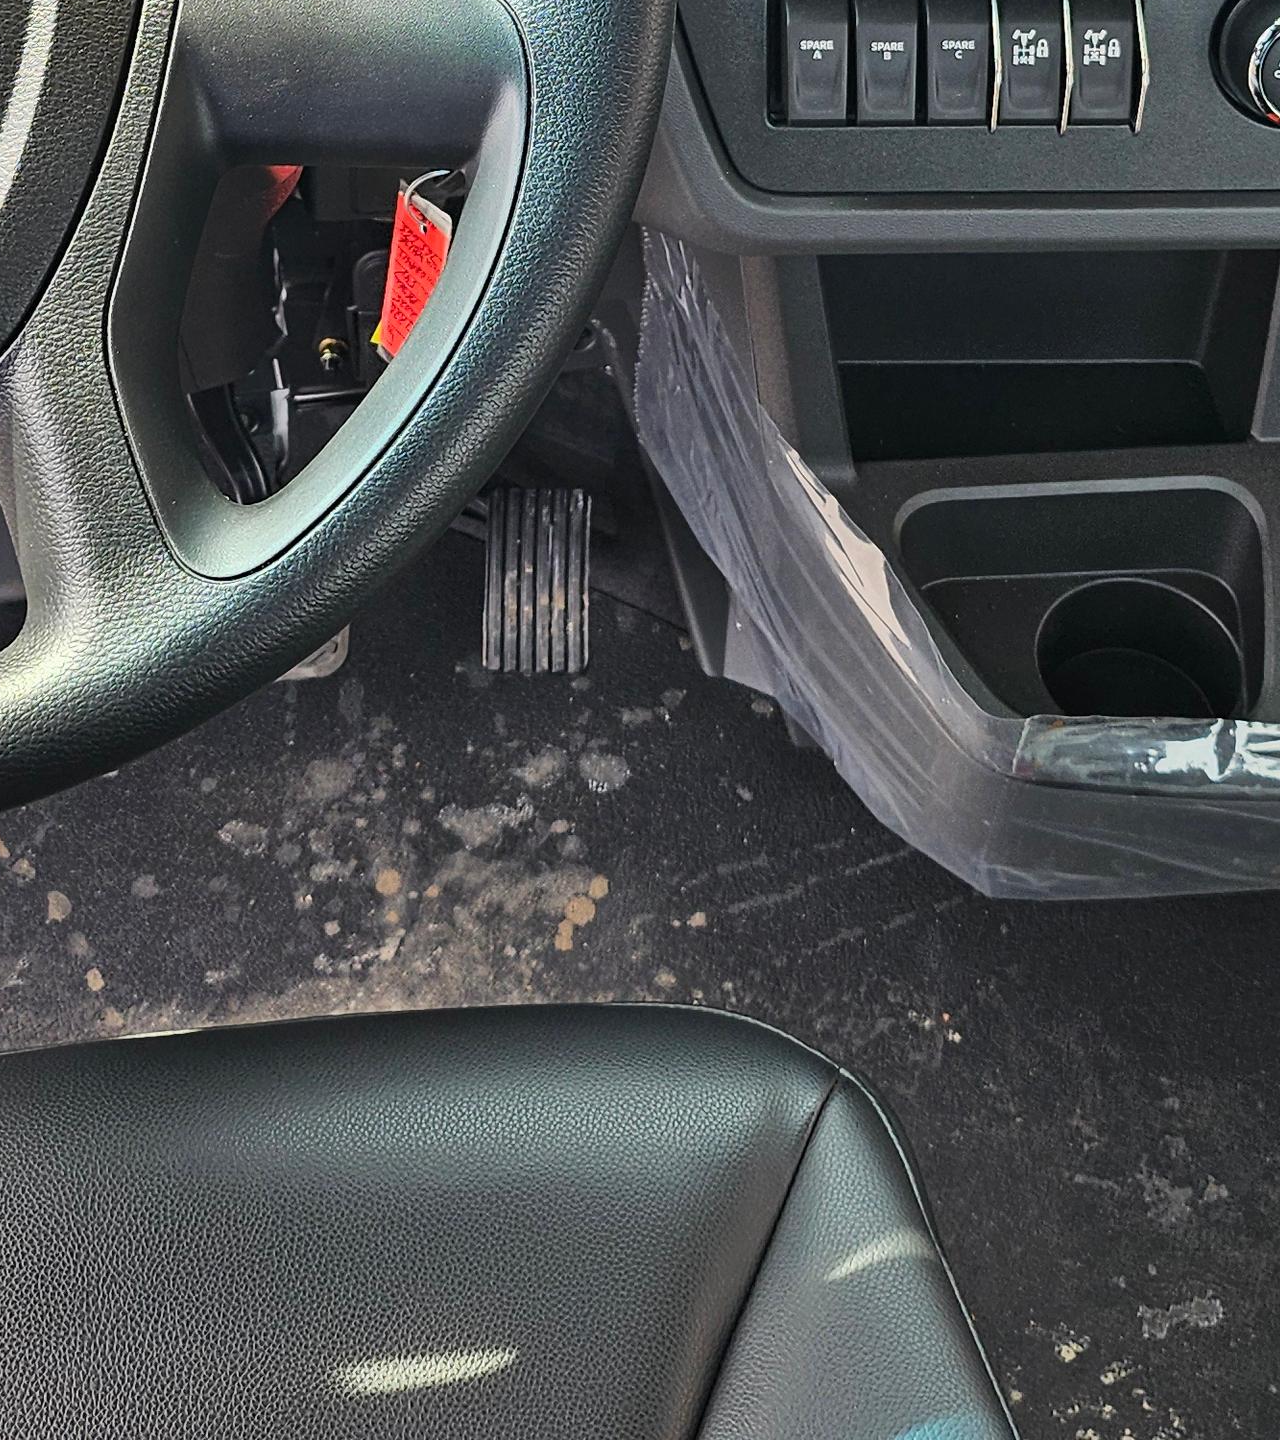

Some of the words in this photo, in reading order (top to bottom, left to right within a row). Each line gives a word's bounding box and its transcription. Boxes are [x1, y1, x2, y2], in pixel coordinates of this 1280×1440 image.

[800, 40, 834, 50] SPARE
[871, 41, 904, 52] SPARE
[942, 40, 975, 51] SPARE
[812, 50, 822, 60] A
[883, 51, 891, 60] B
[954, 50, 963, 59] C
